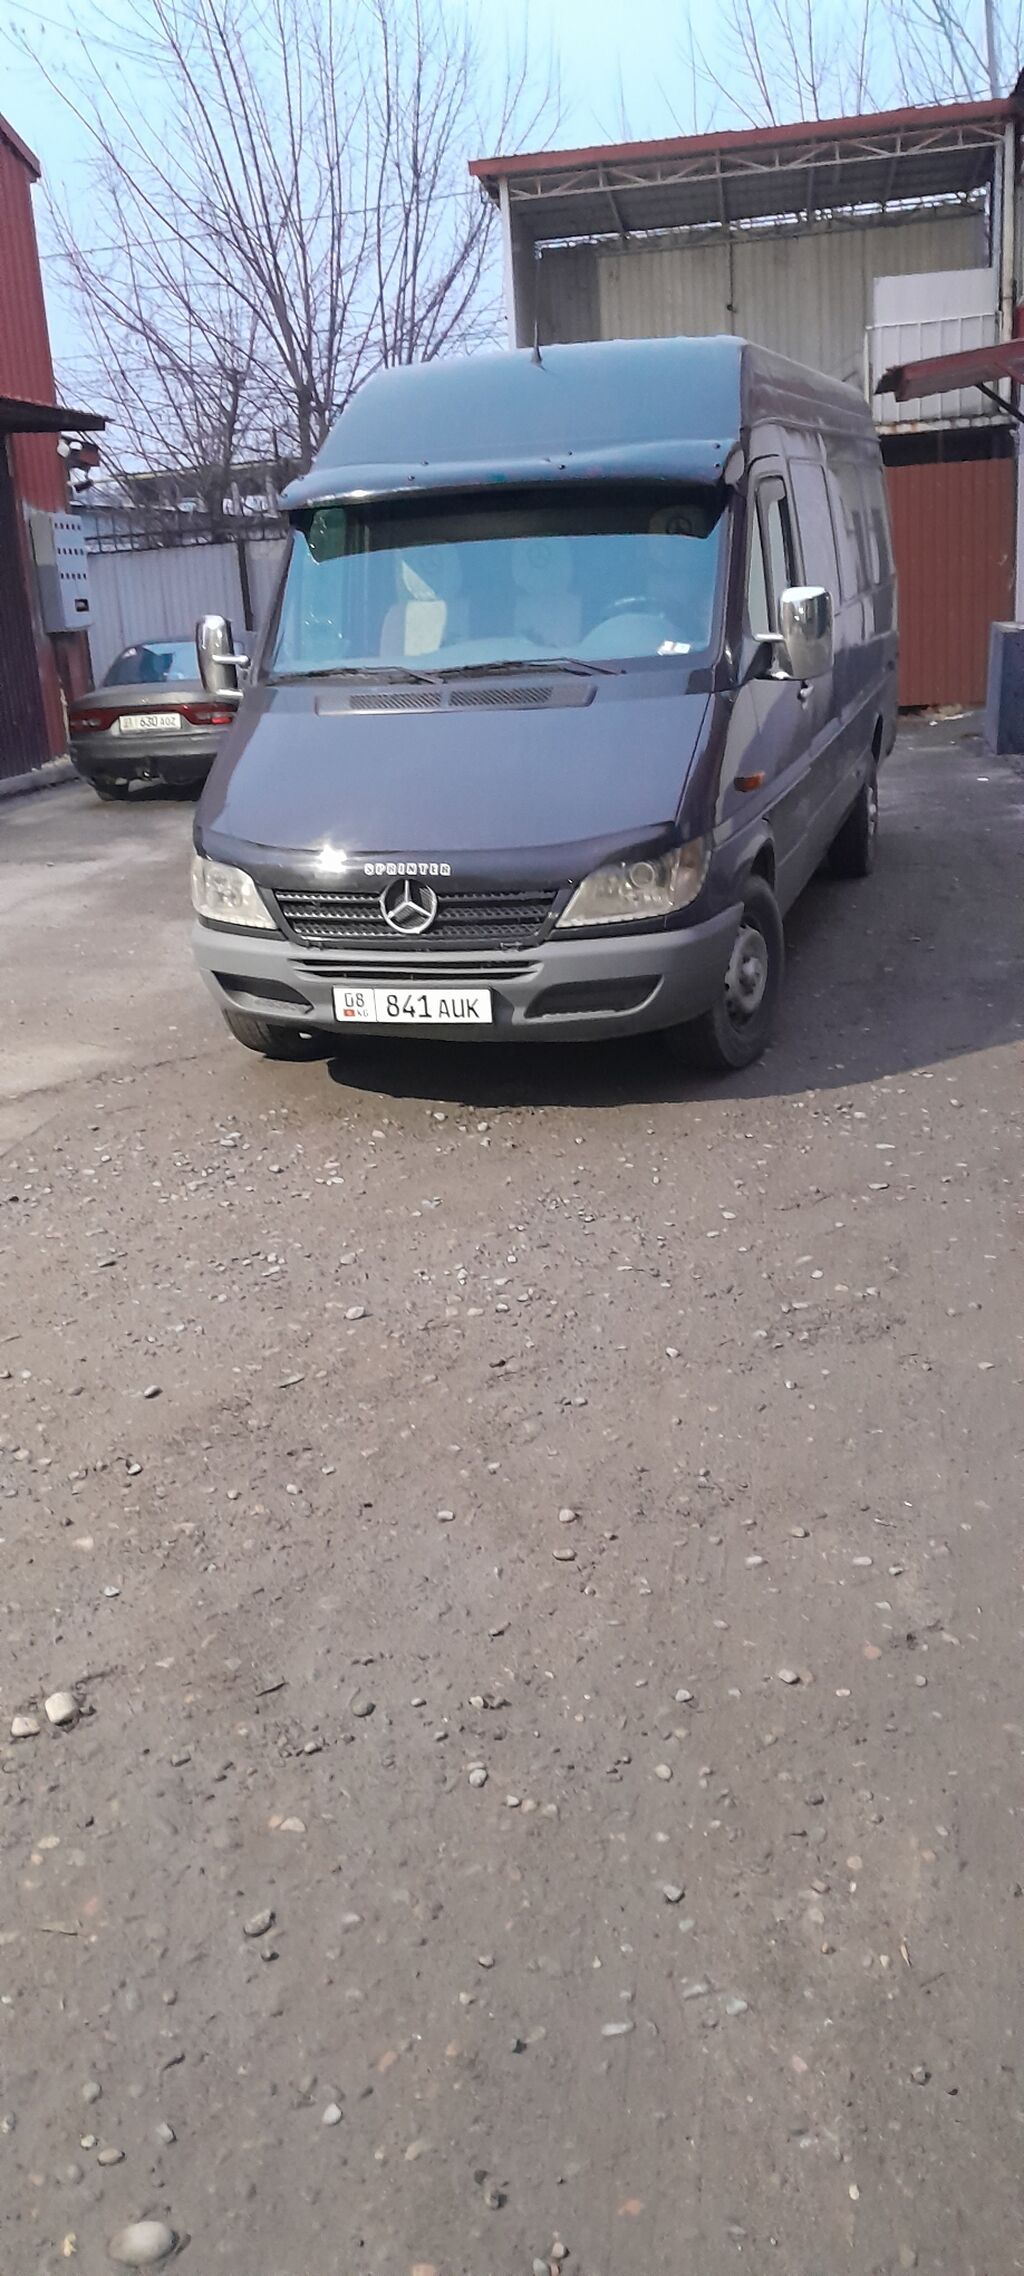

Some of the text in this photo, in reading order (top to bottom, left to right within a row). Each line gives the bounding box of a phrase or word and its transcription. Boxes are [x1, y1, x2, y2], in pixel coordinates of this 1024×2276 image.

[363, 862, 452, 876] SPRINTER
[344, 992, 480, 1018] 08 841 AUK
